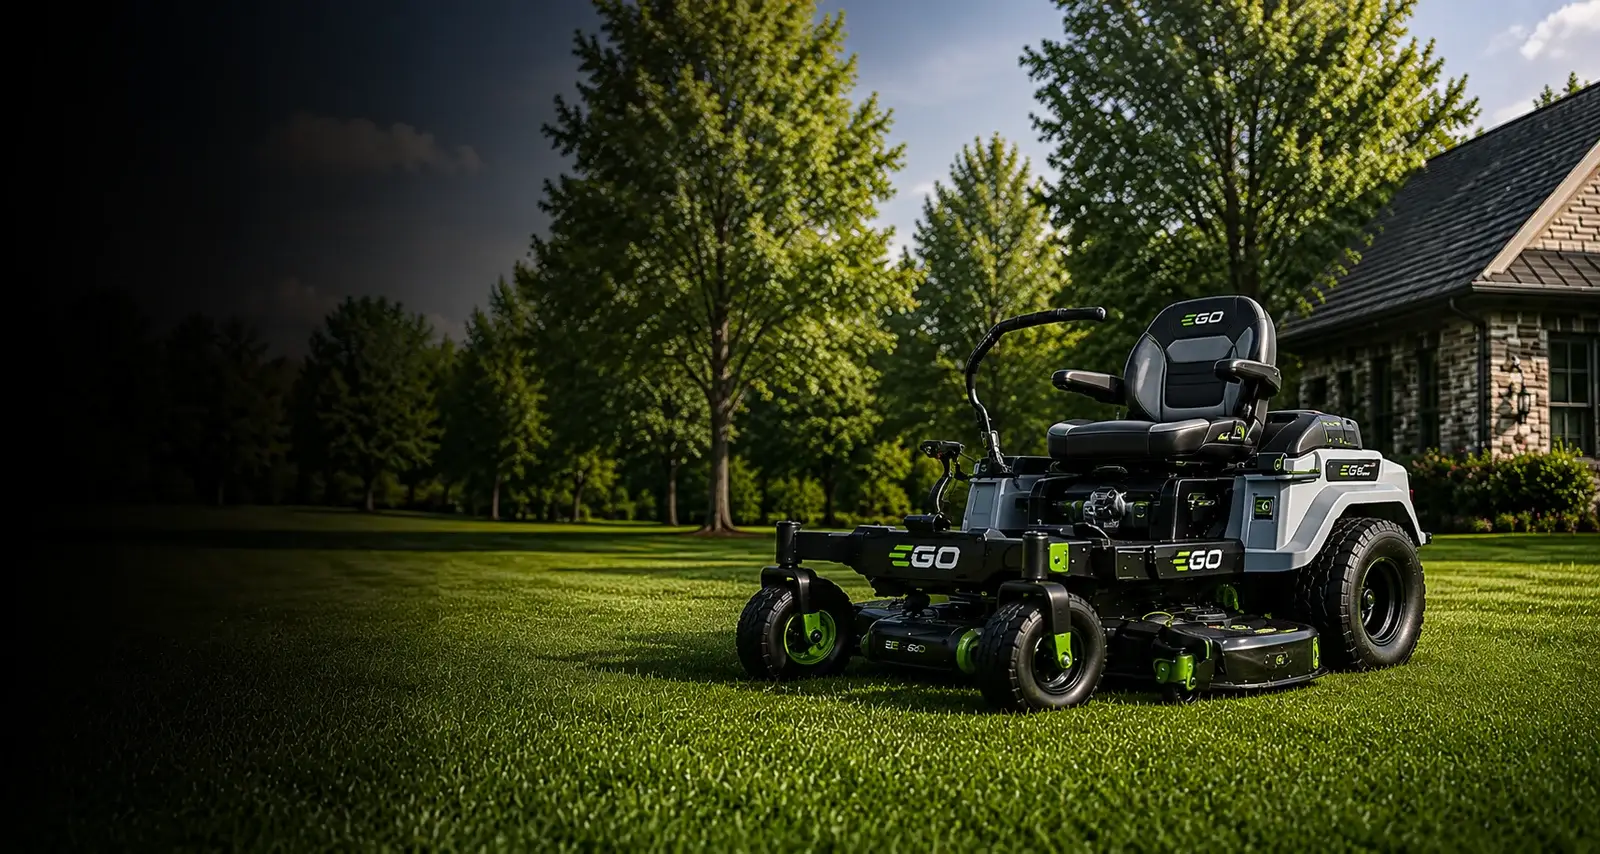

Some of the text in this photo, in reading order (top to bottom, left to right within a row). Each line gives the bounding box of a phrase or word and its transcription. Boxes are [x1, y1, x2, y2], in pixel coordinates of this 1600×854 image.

[1181, 311, 1224, 326] EGO
[889, 545, 960, 569] EGO
[1173, 549, 1222, 571] EGO
